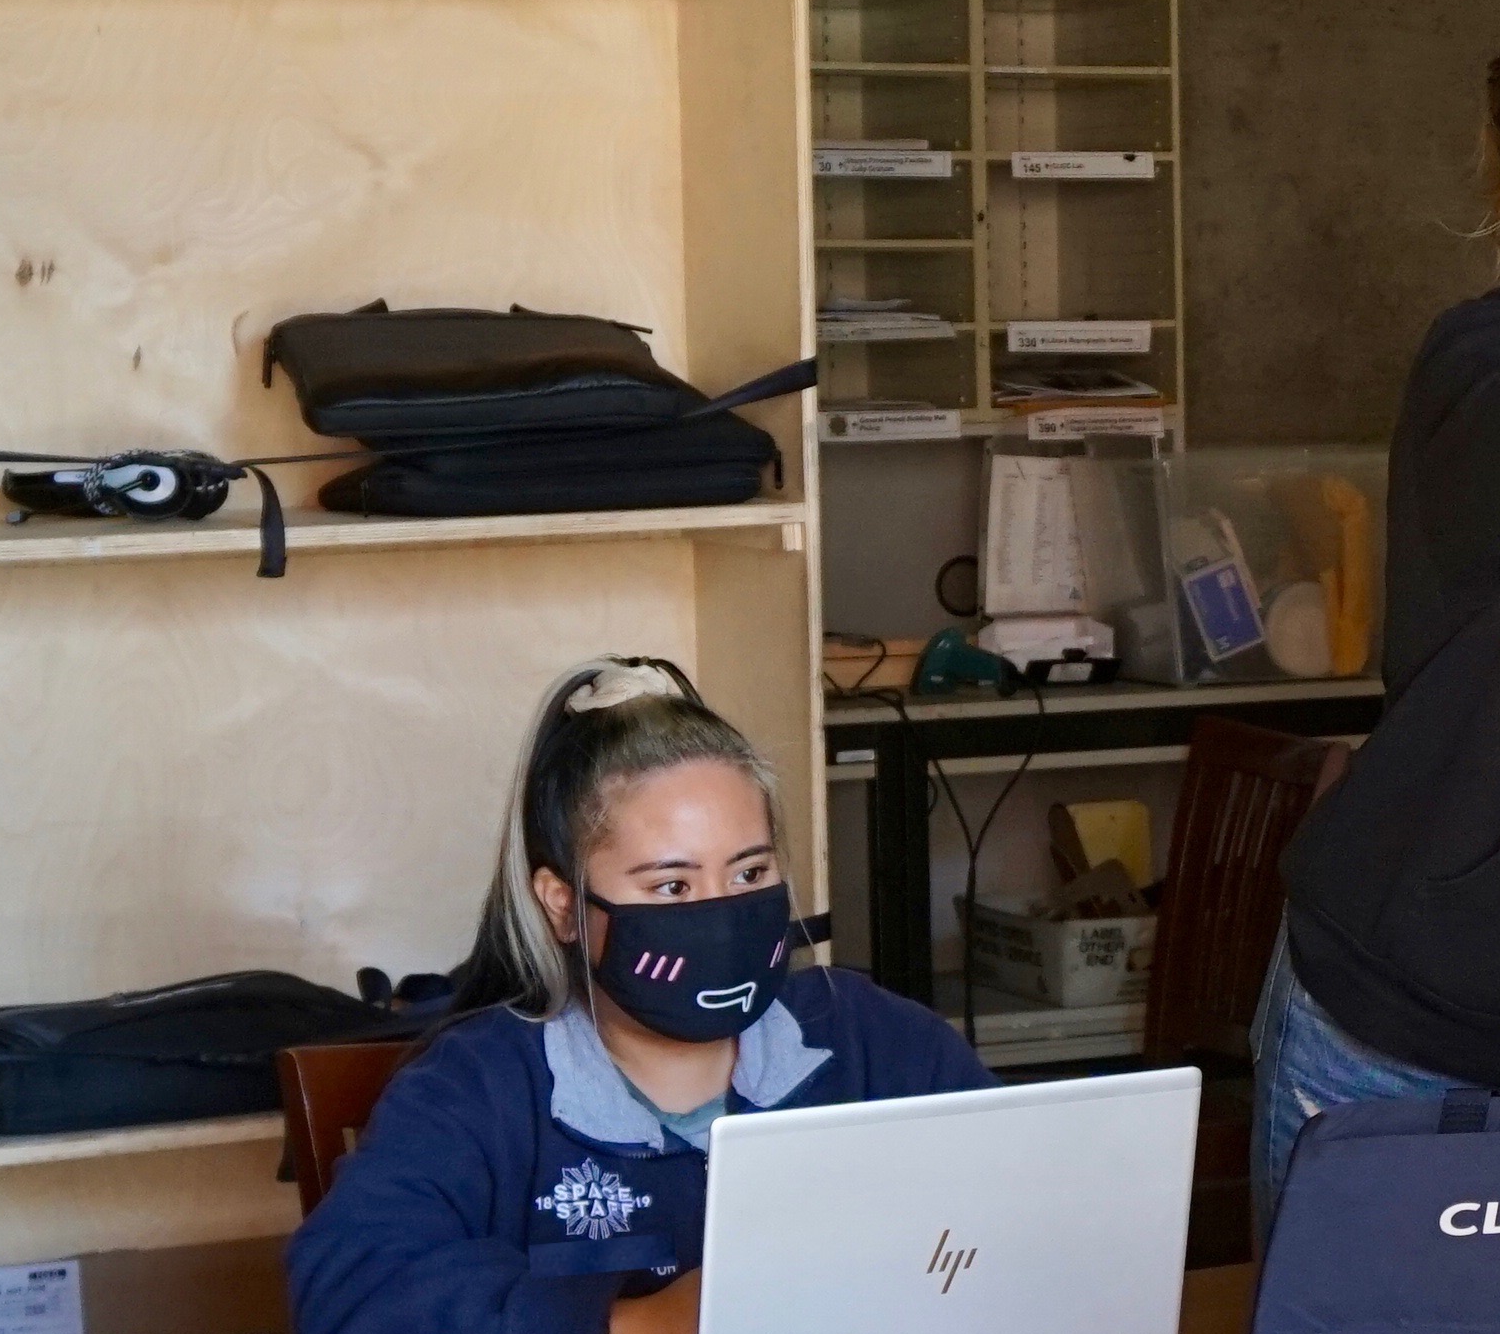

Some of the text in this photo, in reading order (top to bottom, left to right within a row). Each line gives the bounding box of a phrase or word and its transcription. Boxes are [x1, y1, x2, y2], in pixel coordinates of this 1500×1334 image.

[553, 1181, 633, 1202] SPACE
[534, 1196, 553, 1211] 18
[555, 1199, 634, 1220] STAFF
[635, 1195, 653, 1209] 19
